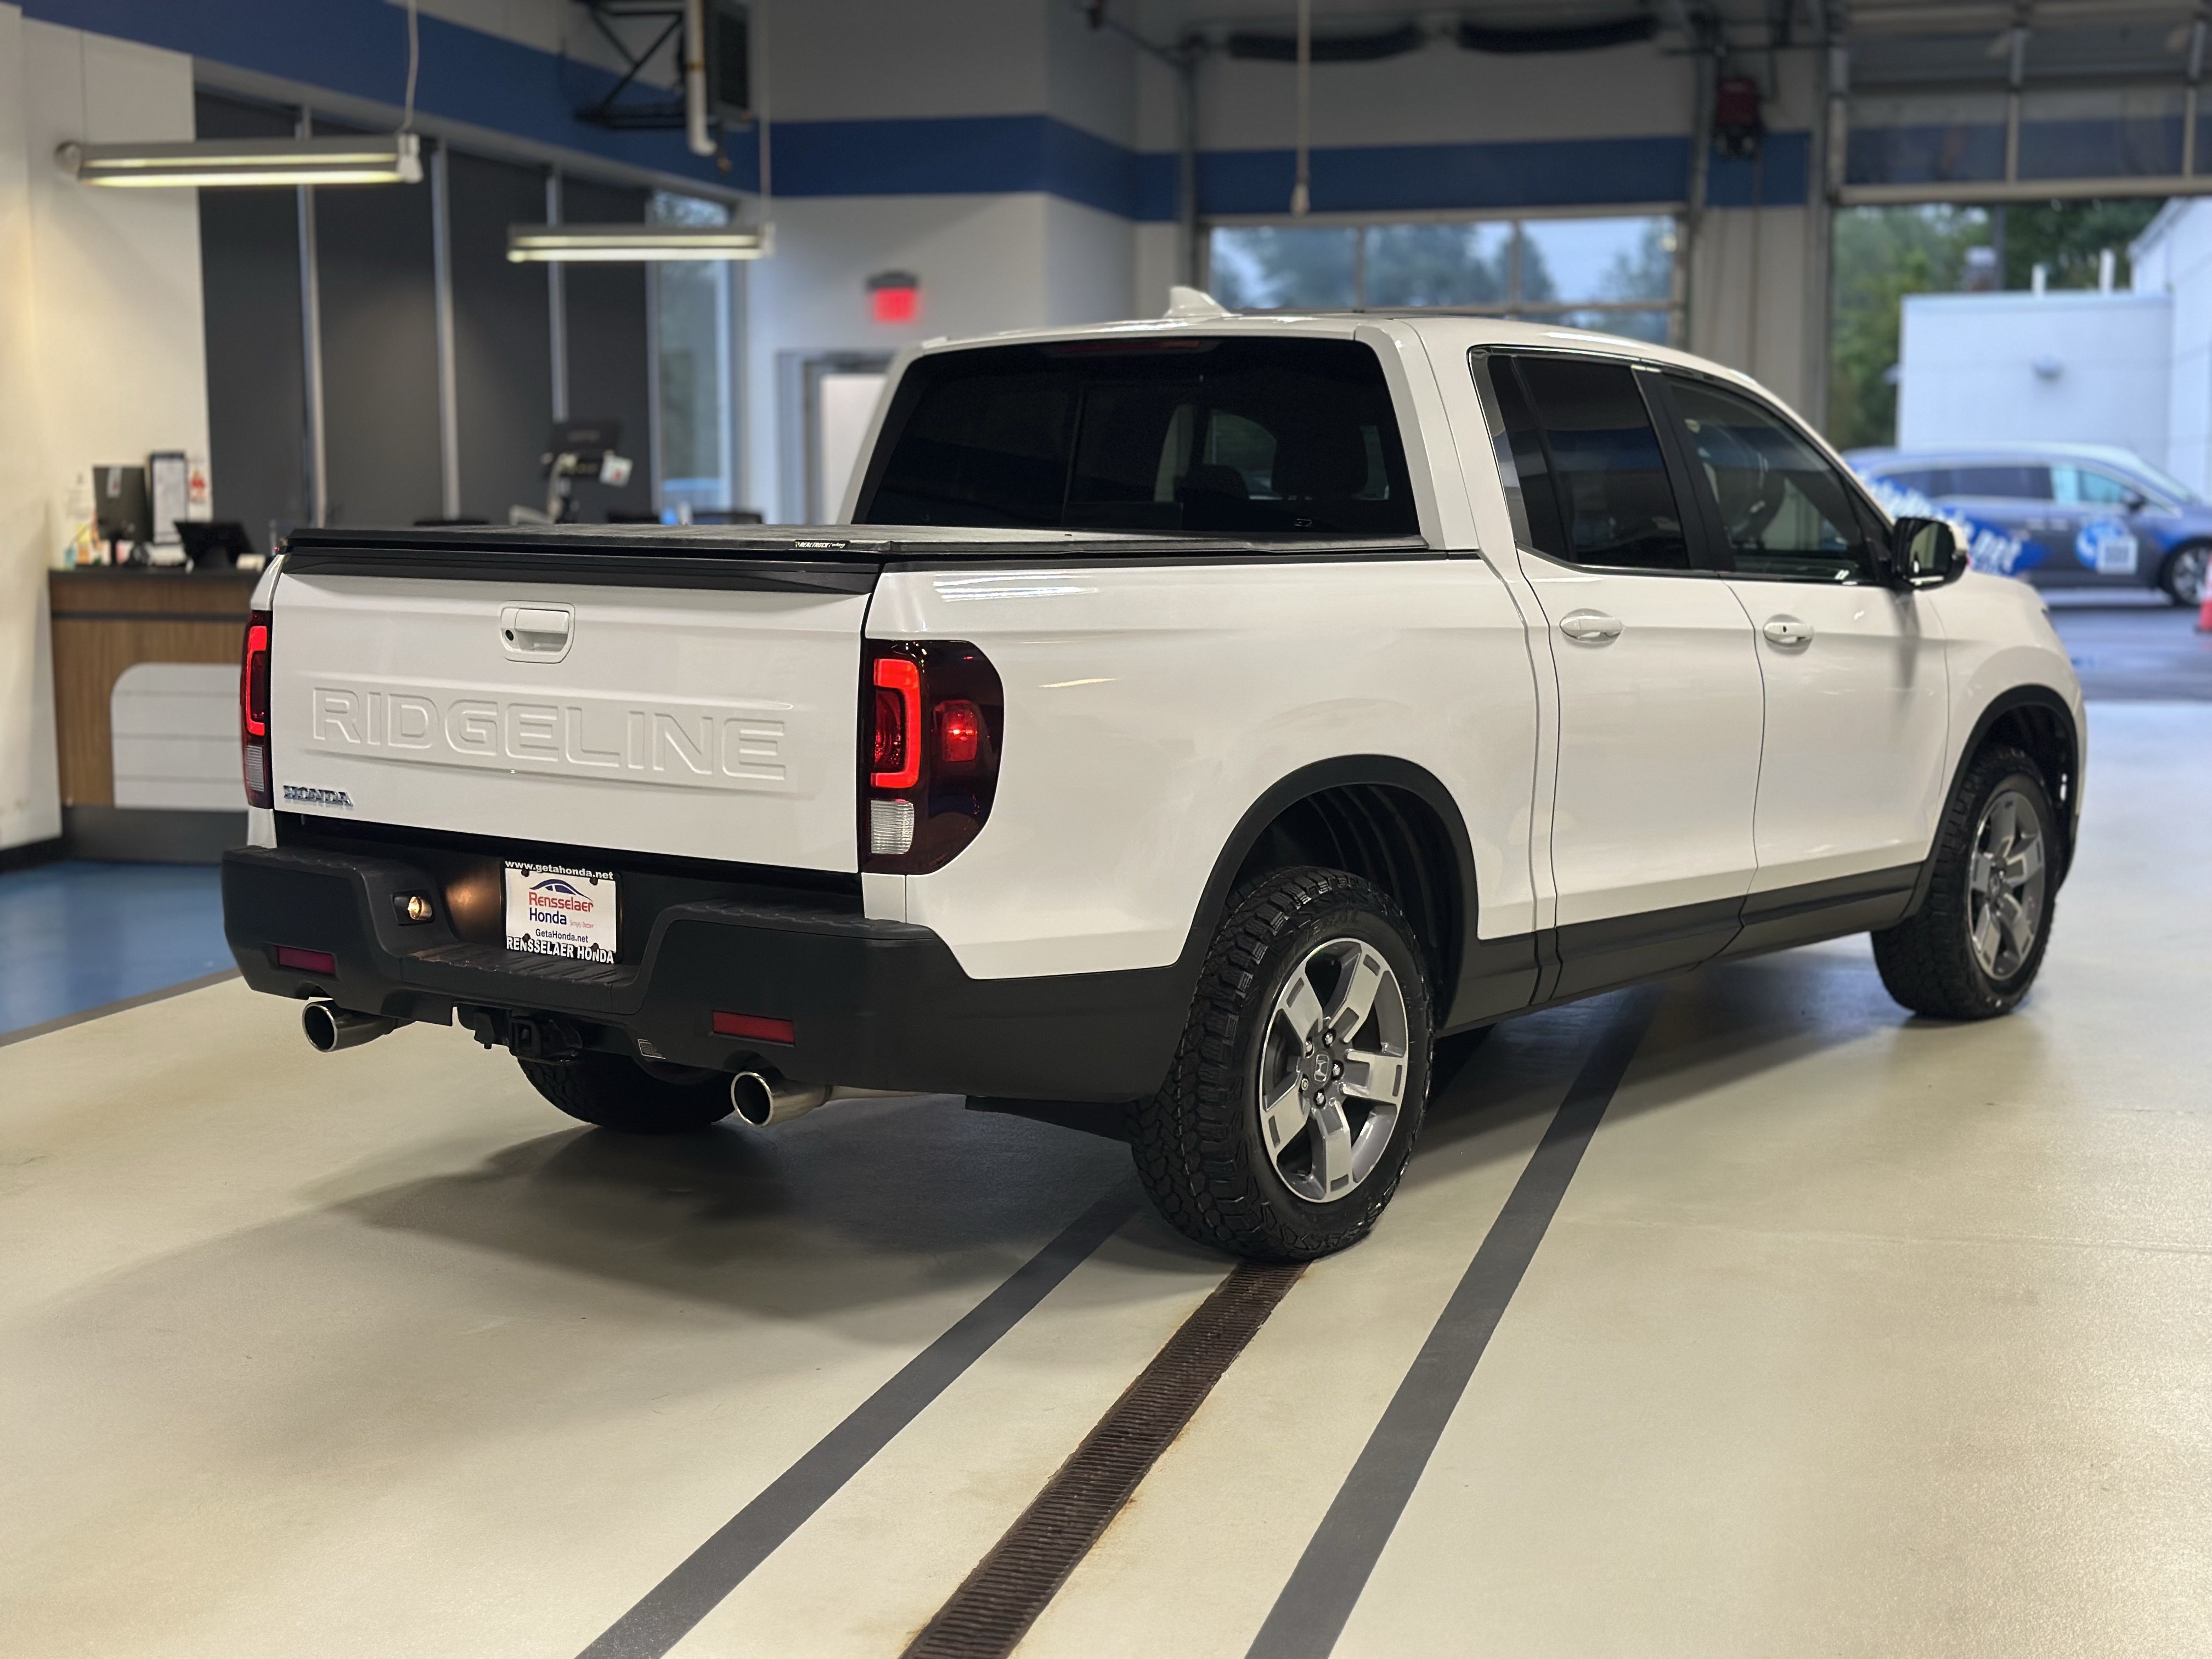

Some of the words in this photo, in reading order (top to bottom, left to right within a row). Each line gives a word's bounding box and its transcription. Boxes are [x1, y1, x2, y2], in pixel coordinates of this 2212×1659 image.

[312, 687, 787, 781] RIDGELINE
[283, 785, 353, 806] HONDA
[505, 860, 614, 879] www.getahonda.net
[528, 891, 594, 913] Rensselaer
[529, 907, 567, 925] Honda
[535, 928, 589, 943] GetaHonda.net
[506, 936, 574, 958] RENSSELAER
[577, 945, 614, 964] HONDA
